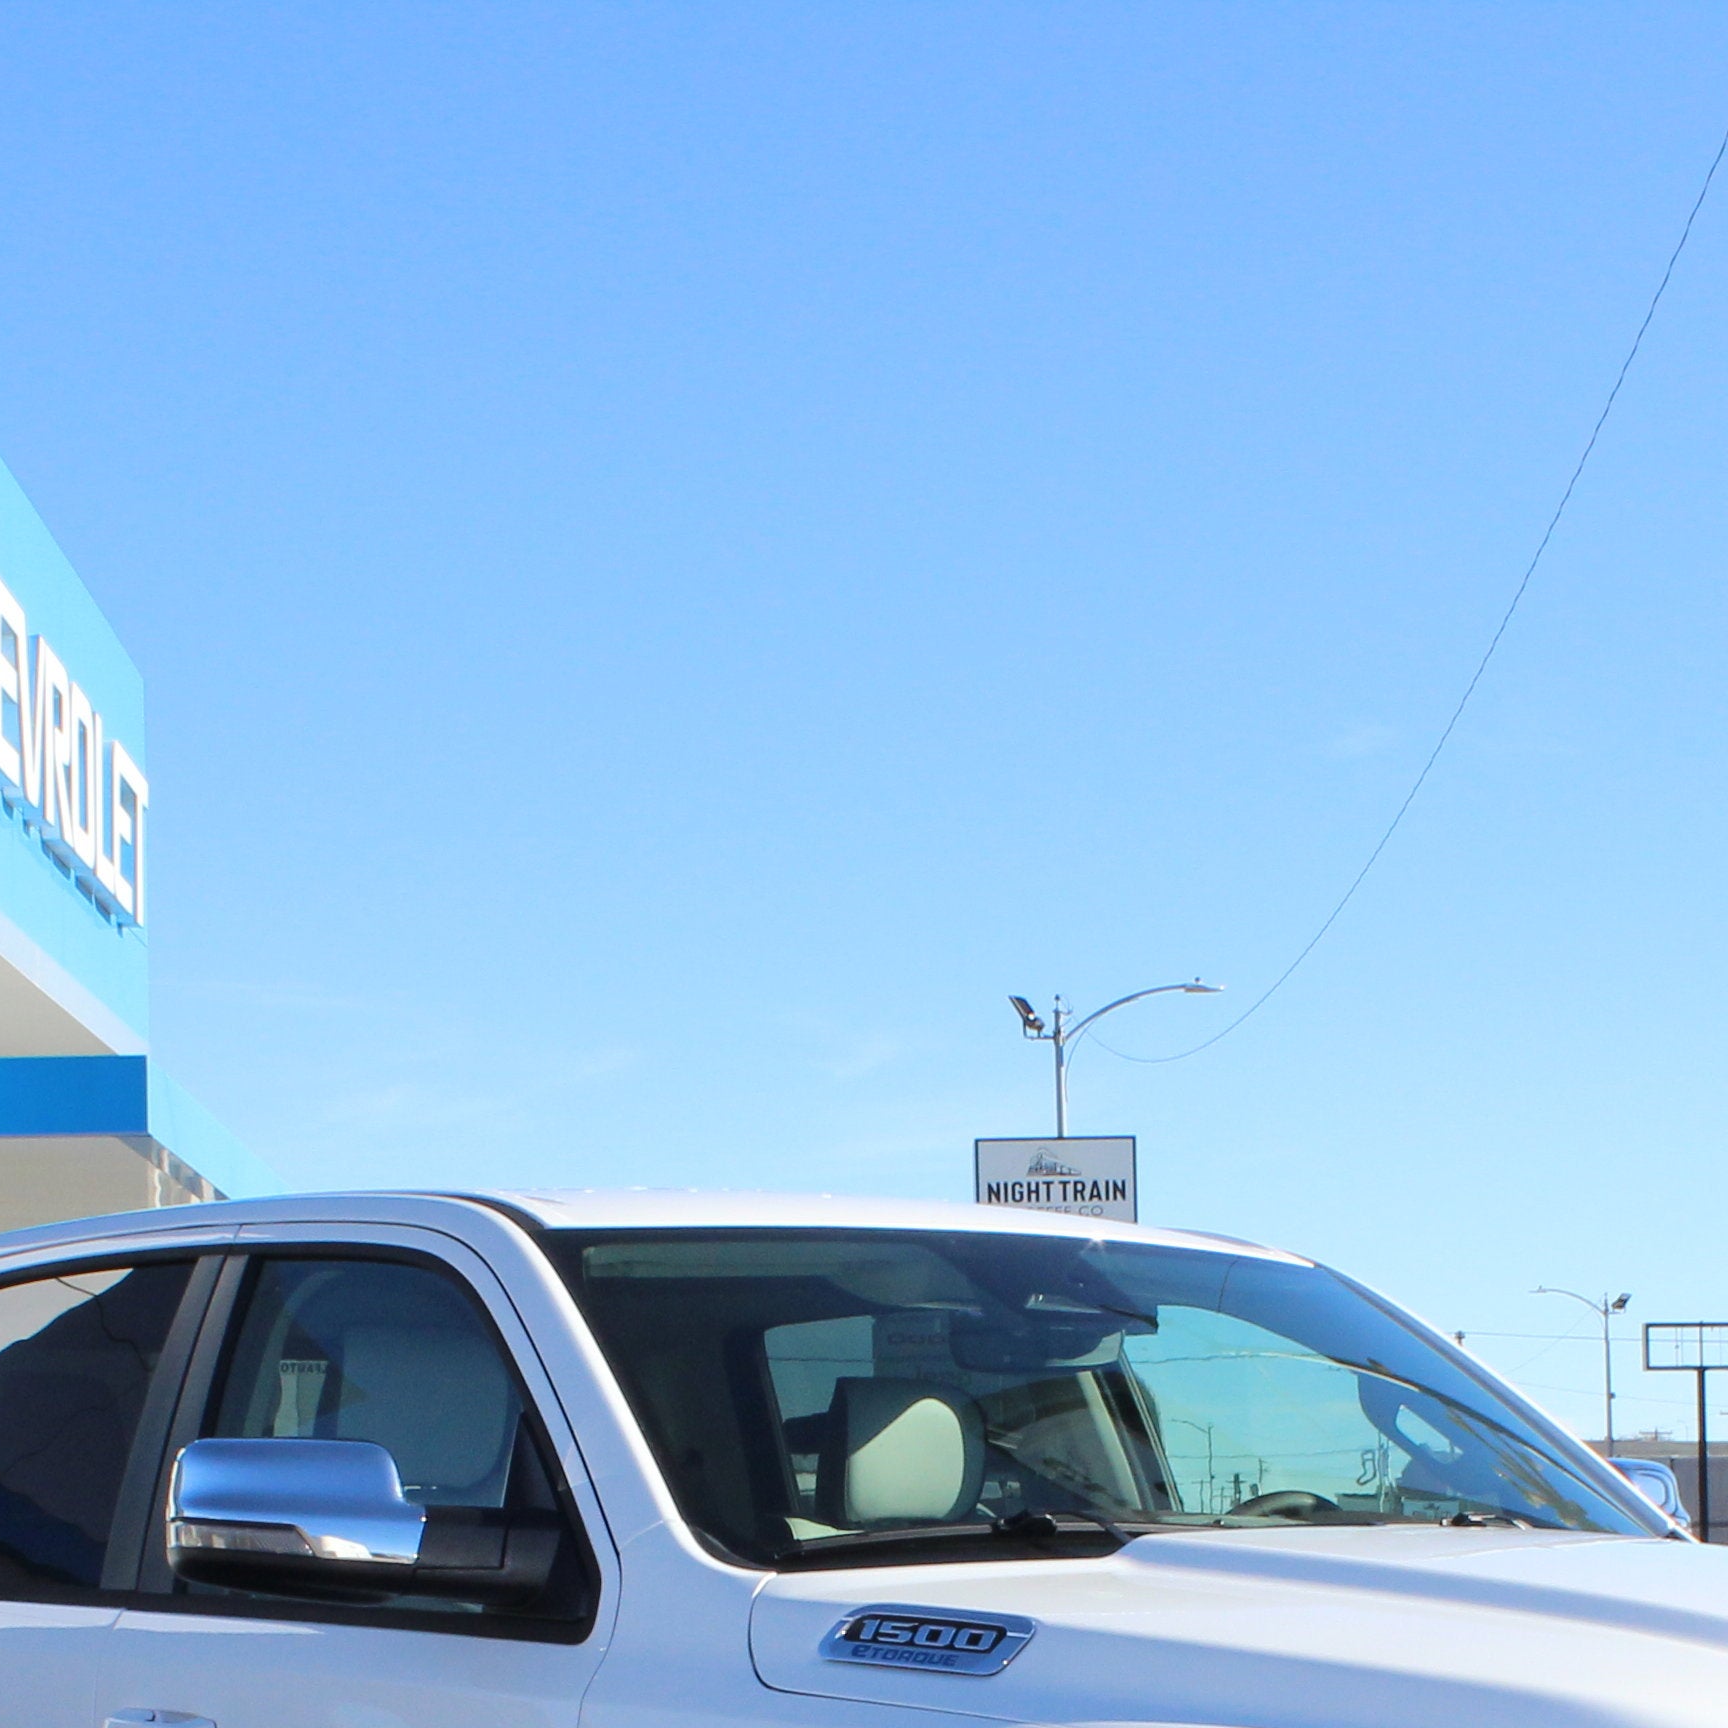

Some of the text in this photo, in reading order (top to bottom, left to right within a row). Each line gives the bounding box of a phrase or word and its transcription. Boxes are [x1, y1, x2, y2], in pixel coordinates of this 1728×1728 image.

[987, 1178, 1127, 1203] NIGHT TRAIN
[860, 1618, 998, 1651] 1500
